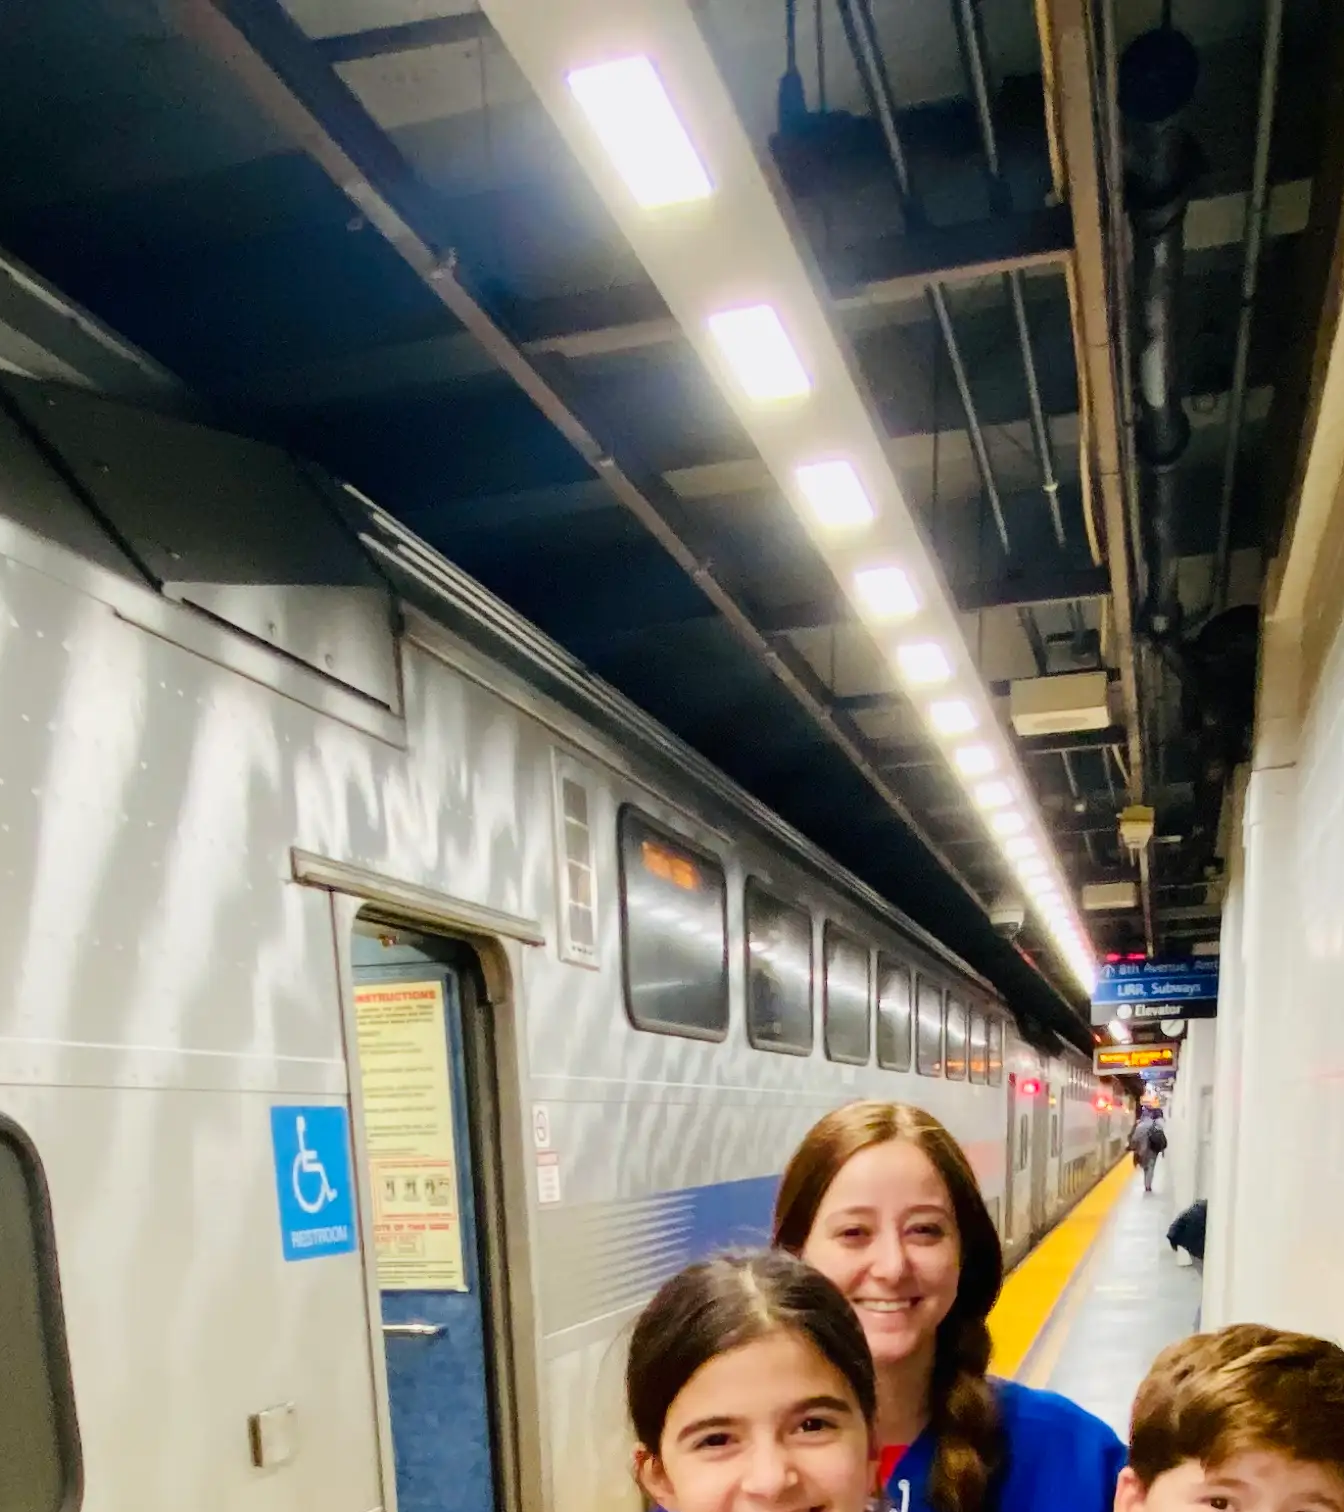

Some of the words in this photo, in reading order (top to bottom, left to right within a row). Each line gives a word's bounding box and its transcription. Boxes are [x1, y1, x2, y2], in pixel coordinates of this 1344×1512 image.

[1118, 963, 1140, 975] 8th
[1151, 981, 1201, 996] Subways
[1135, 1003, 1184, 1017] Elevator
